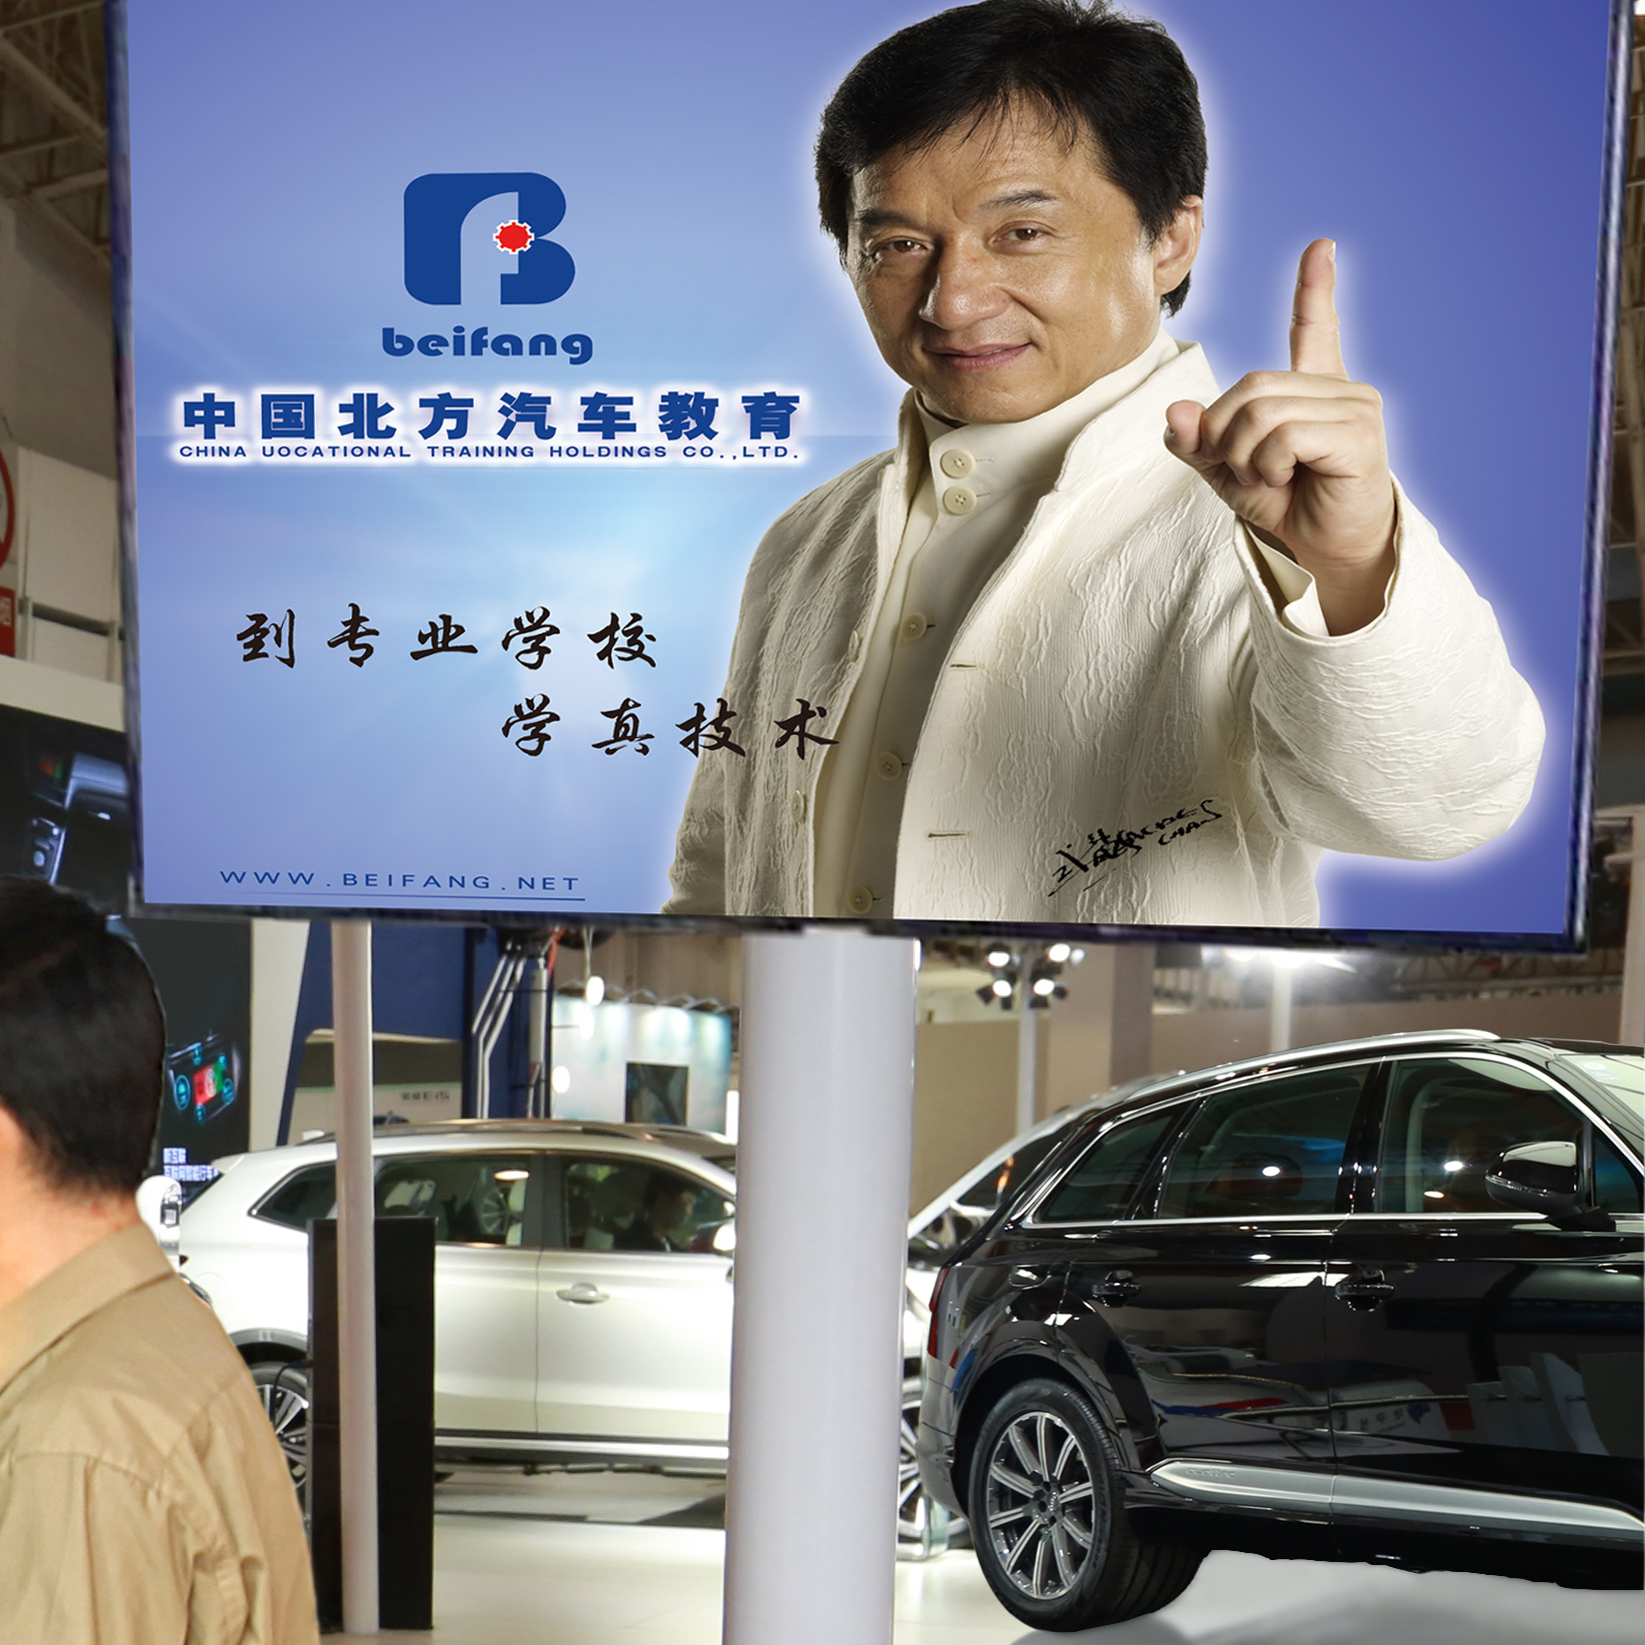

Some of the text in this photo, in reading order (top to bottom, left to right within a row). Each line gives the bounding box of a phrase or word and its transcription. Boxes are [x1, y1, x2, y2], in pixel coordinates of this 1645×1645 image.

[382, 325, 594, 365] beifang
[183, 391, 801, 441] 中国北方汽车教育
[179, 445, 247, 458] CHINA
[427, 445, 535, 458] TRAINING
[549, 445, 667, 458] HOLDINGS
[235, 602, 658, 670] 到专业学校
[501, 697, 839, 758] 学真技术
[220, 868, 580, 894] WWW.BEIFANG.NET
